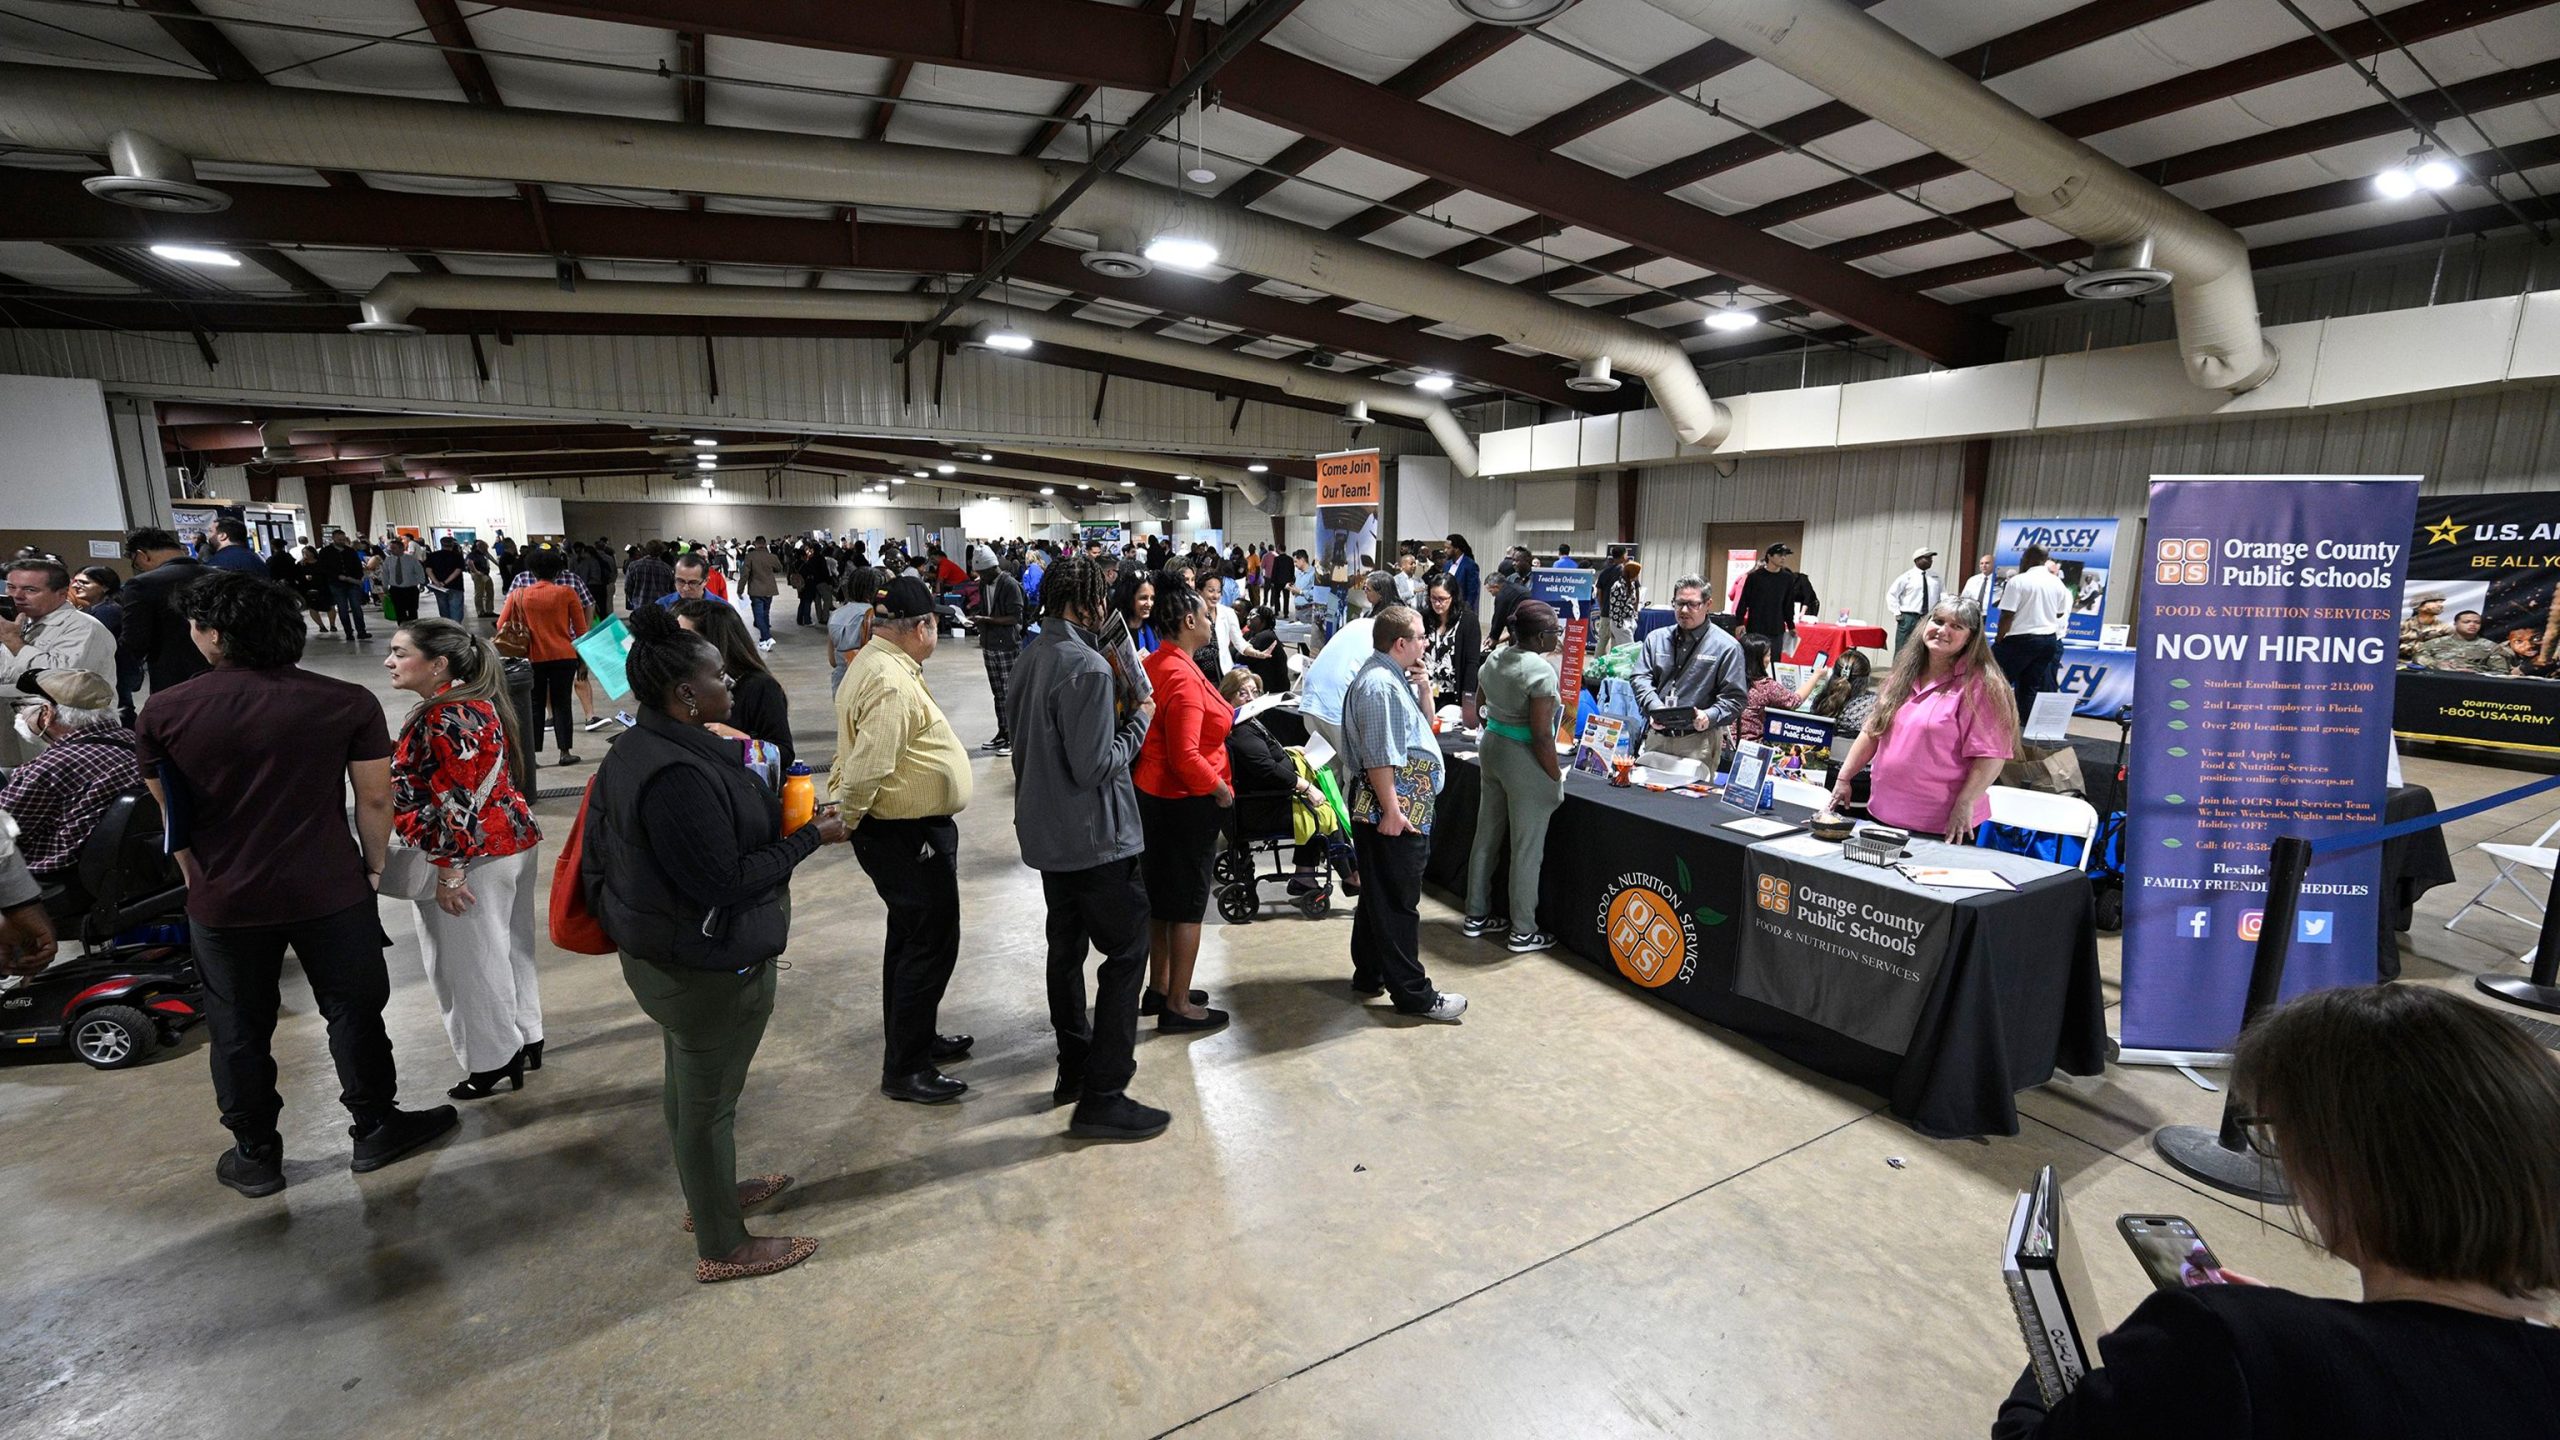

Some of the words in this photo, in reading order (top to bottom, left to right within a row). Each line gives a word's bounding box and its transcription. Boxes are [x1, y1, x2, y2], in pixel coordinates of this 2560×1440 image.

[1322, 463, 1348, 476] Come
[1349, 459, 1371, 474] Join
[1322, 485, 1339, 499] Our
[1341, 482, 1371, 497] Team!
[2014, 526, 2100, 548] MASSEY
[2474, 523, 2524, 541] U.S.
[2224, 539, 2308, 565] Orange
[2315, 540, 2400, 567] County
[2471, 555, 2498, 567] BE
[2501, 555, 2540, 567] ALL
[2222, 566, 2294, 586] Public
[2300, 567, 2392, 588] Schools
[1559, 585, 1575, 593] OCPS
[2155, 606, 2201, 617] FOOD
[2205, 606, 2217, 617] &
[2221, 606, 2309, 618] NUTRITION
[2314, 608, 2391, 620] SERVICES
[2155, 634, 2248, 661] NOW
[2259, 636, 2385, 664] HIRING
[2204, 680, 2242, 690] Student
[2246, 680, 2301, 691] Enrollment
[2330, 682, 2374, 692] 213,000
[2203, 700, 2223, 710] 2nd
[2226, 701, 2263, 713] Largest
[2267, 702, 2313, 714] employer
[2316, 703, 2326, 712] in
[2329, 703, 2363, 713] Florida
[2462, 699, 2532, 713] goarmy.com
[2439, 706, 2555, 726] 1-800-USA-ARMY
[1784, 723, 1804, 732] Orange
[1805, 726, 1825, 736] County
[2202, 721, 2228, 731] Over
[2229, 721, 2251, 731] 200
[2254, 722, 2298, 732] locations
[2301, 723, 2320, 733] and
[2322, 725, 2361, 735] growing
[1783, 731, 1799, 739] Public
[1801, 734, 1822, 743] Schools
[2201, 748, 2224, 758] View
[2227, 749, 2245, 759] and
[2249, 750, 2277, 761] Apply
[2281, 751, 2291, 760] to
[2201, 761, 2225, 770] Food
[2227, 762, 2236, 770] &
[2240, 762, 2285, 772] Nutrition
[2288, 763, 2329, 773] Services
[2200, 773, 2243, 784] positions
[2246, 774, 2277, 784] online
[2280, 776, 2355, 788] @www.ocps.net
[2198, 796, 2219, 806] Join
[2222, 797, 2238, 806] the
[2241, 797, 2273, 807] OCPS
[2275, 798, 2298, 808] Food
[2301, 799, 2342, 809] Services
[2345, 801, 2370, 810] Team
[2198, 808, 2212, 817] We
[2215, 808, 2235, 817] have
[2240, 809, 2290, 820] Weekends,
[2293, 811, 2323, 822] Nights
[2326, 812, 2343, 821] and
[2345, 812, 2377, 822] School
[2198, 820, 2239, 831] Holidays
[2241, 821, 2268, 831] OFF!
[2195, 840, 2218, 850] Call:
[2221, 841, 2271, 852] 407-858-
[2213, 863, 2265, 876] Flexible
[2143, 876, 2202, 890] FAMILY
[2204, 879, 2268, 892] FRIENDL
[2301, 883, 2369, 896] HEDULES
[1799, 886, 1857, 917] Orange
[1861, 904, 1925, 940] County
[1597, 893, 1611, 934] FOOD
[1607, 883, 1620, 895] &
[1618, 872, 1683, 909] NUTRITION
[1679, 913, 1698, 984] SERVICES
[1797, 905, 1845, 934] Public
[1849, 922, 1916, 956] Schools
[1756, 917, 1782, 936] FOOD
[1783, 929, 1793, 940] &
[1796, 932, 1859, 961] NUTRITION
[1861, 954, 1920, 983] SERVICES
